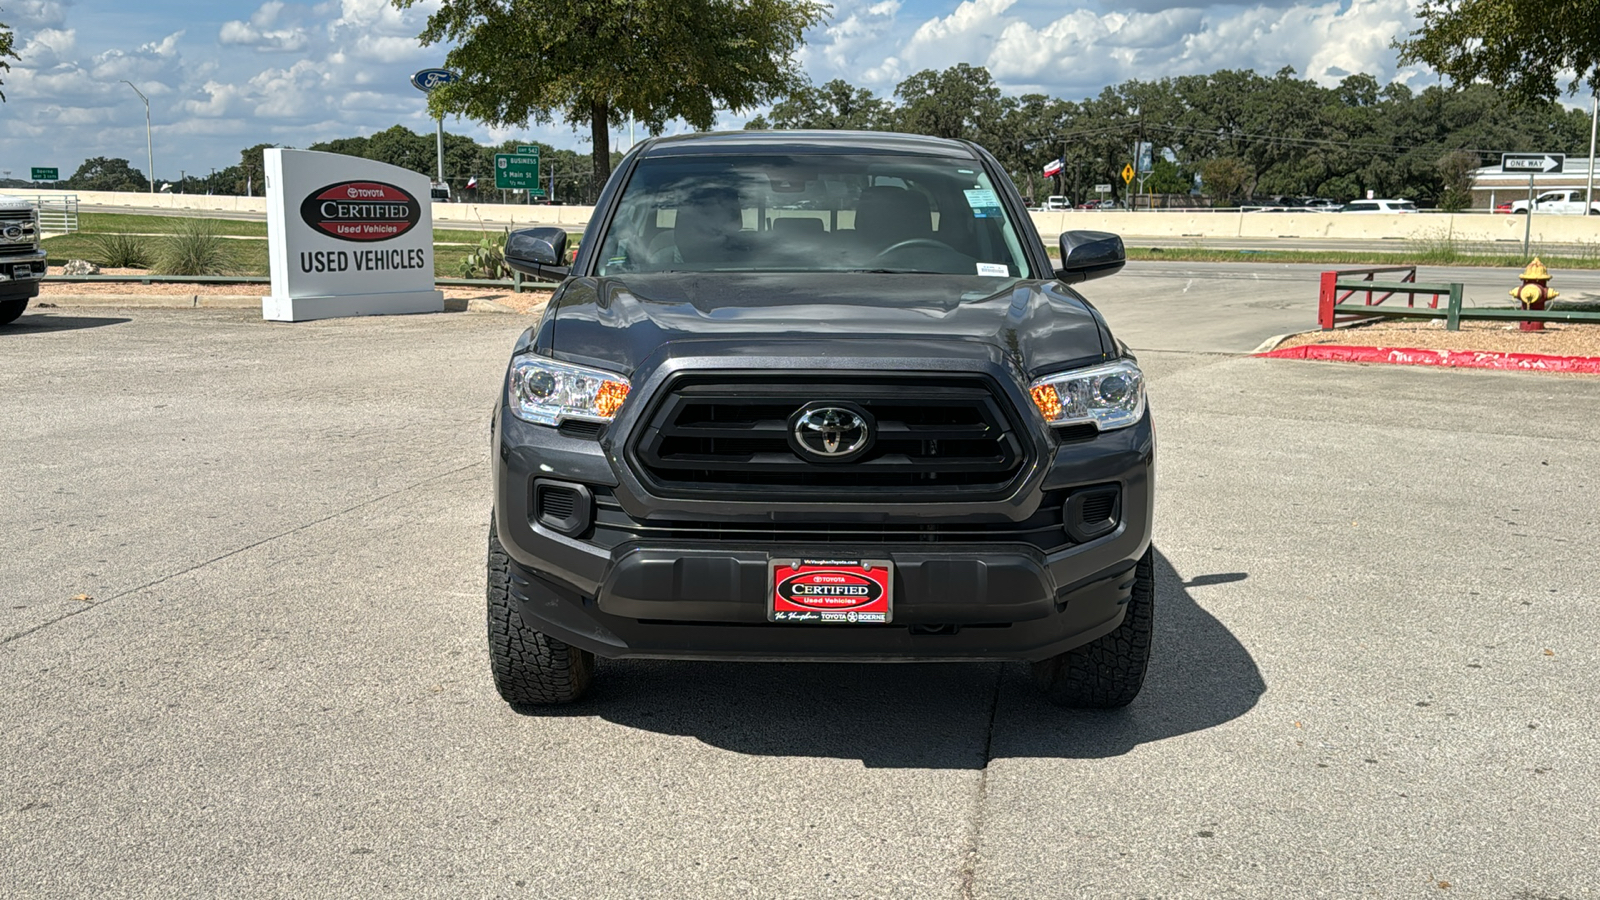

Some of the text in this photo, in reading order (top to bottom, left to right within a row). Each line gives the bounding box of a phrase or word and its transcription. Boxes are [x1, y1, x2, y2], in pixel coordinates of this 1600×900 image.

[358, 189, 385, 198] TOYOTA
[320, 201, 410, 219] CERTIFIED
[337, 224, 397, 234] Used Vehicles
[300, 248, 425, 274] USED VEHICLES
[791, 583, 869, 595] CERTIFIED
